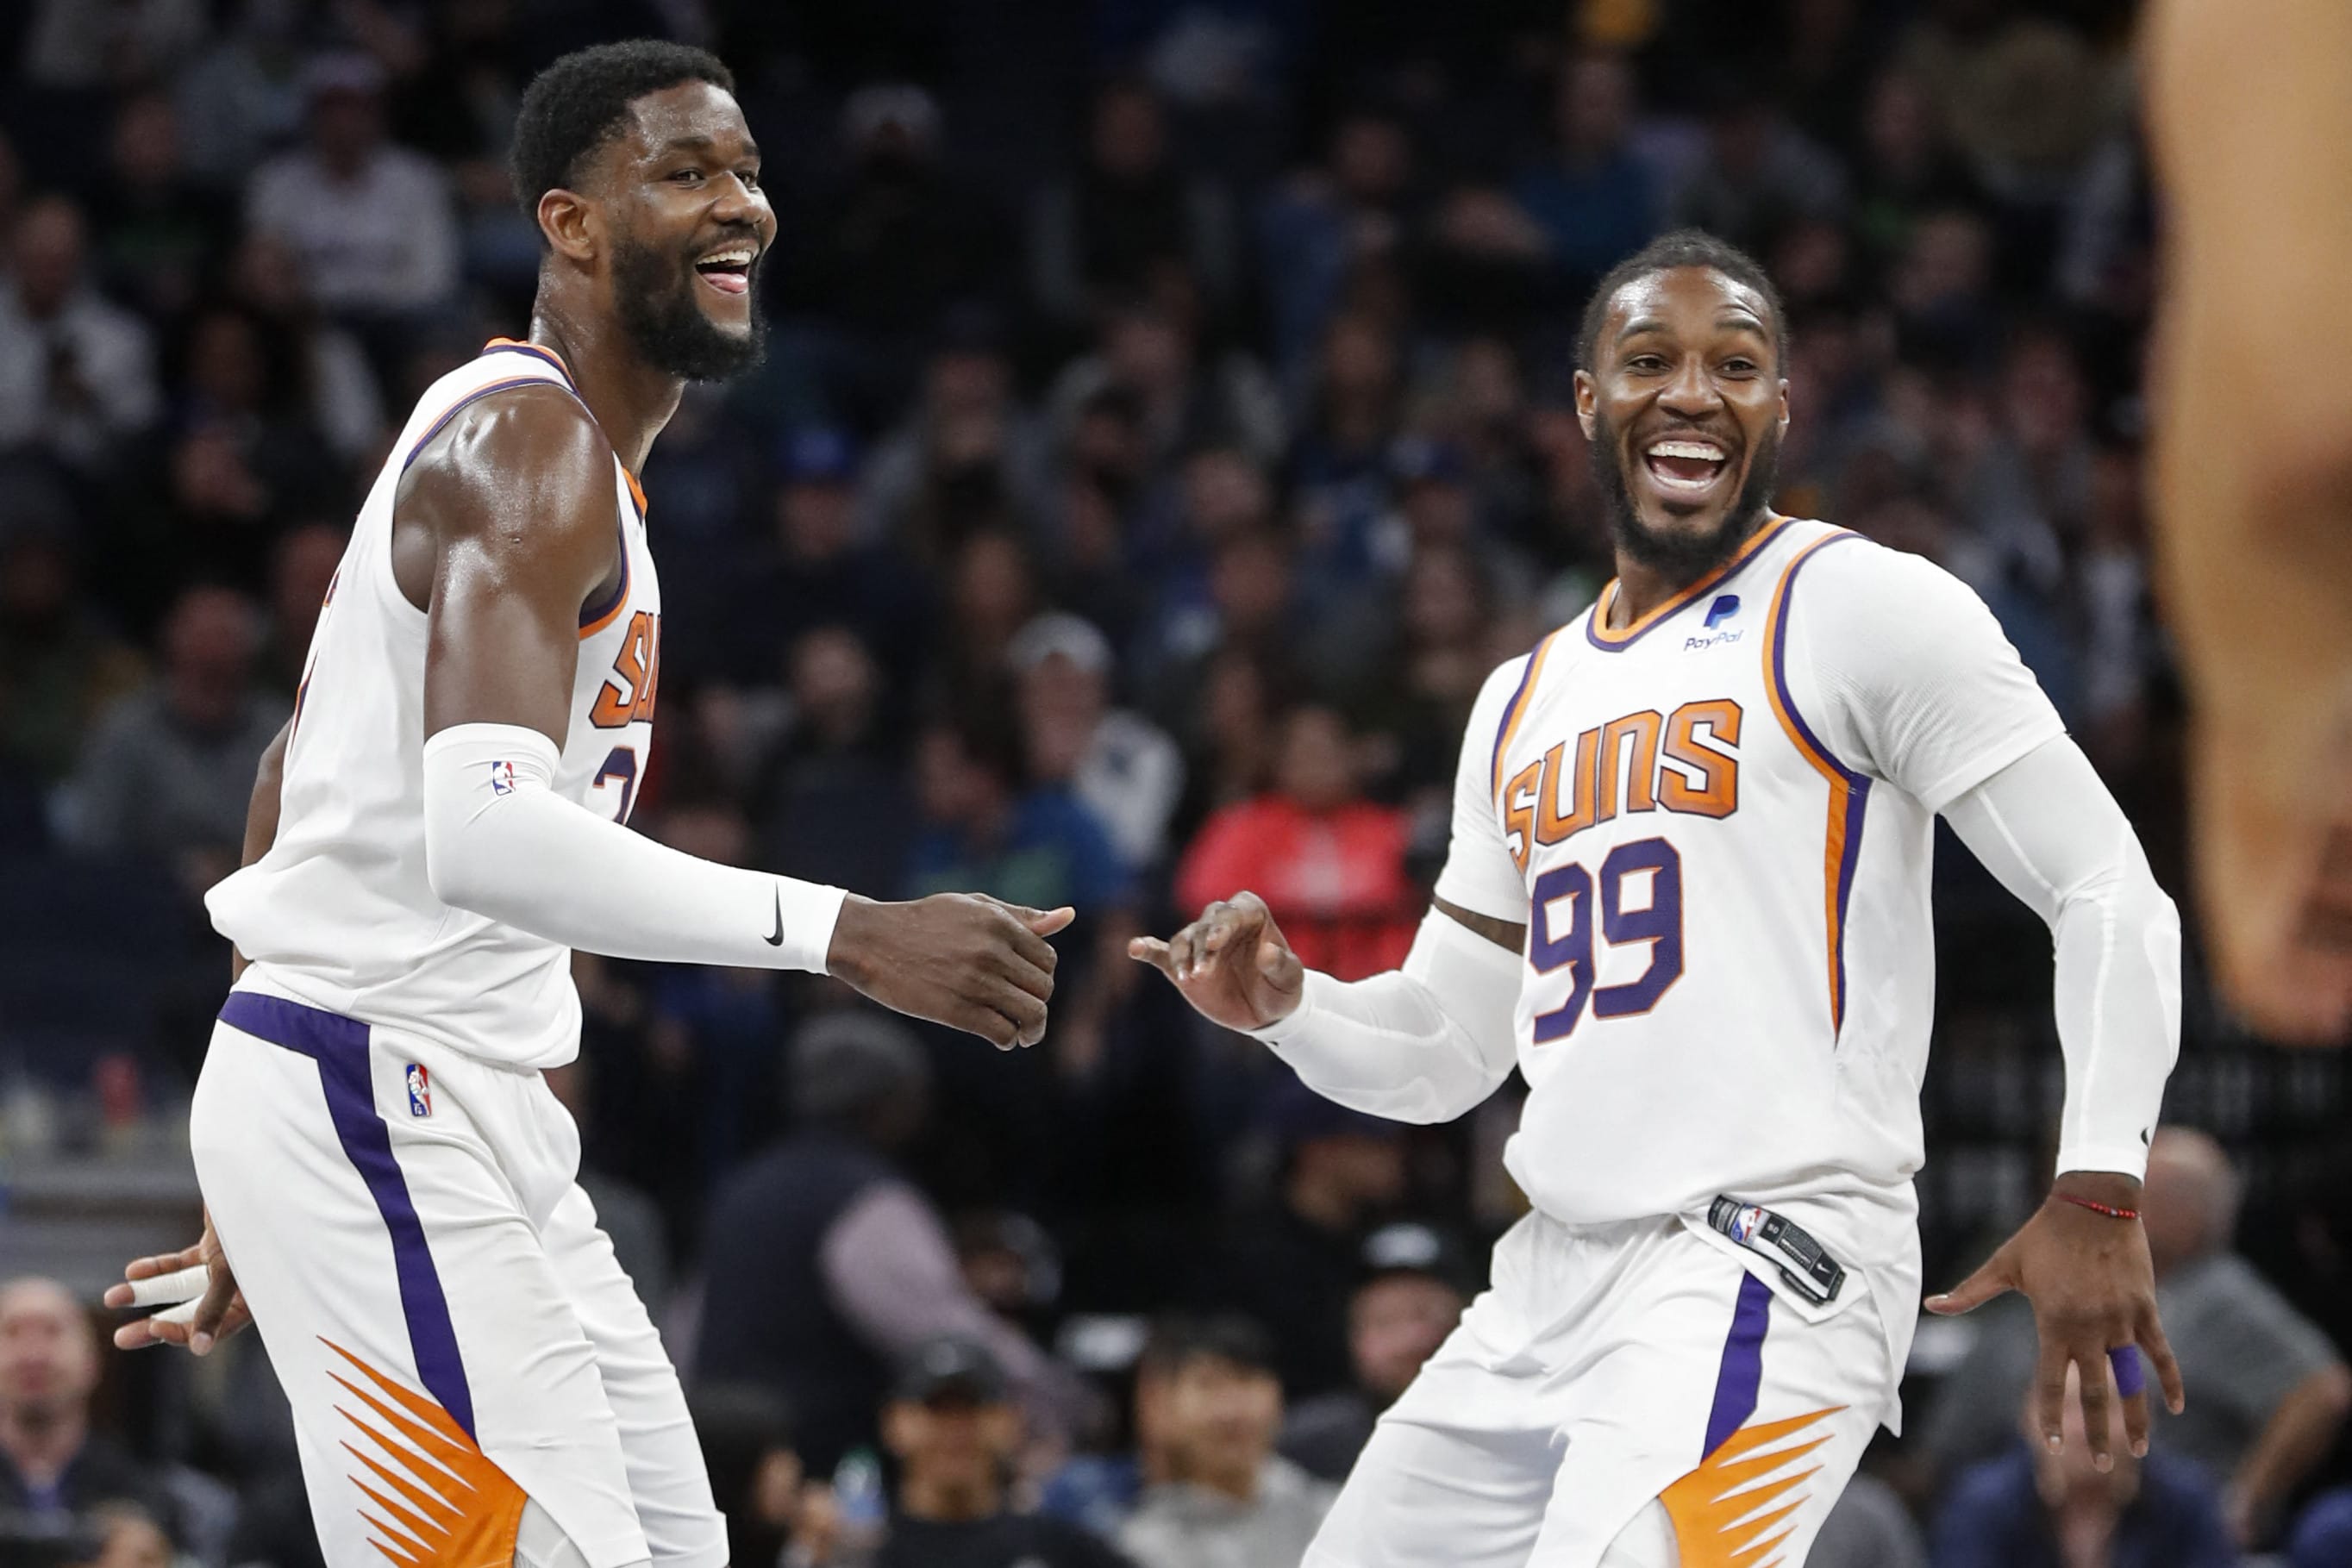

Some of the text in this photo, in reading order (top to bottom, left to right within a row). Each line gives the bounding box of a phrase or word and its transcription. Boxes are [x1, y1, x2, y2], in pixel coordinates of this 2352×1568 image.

[1684, 629, 1744, 652] PayPal
[1504, 698, 1742, 874] SUNS
[1529, 836, 1685, 1046] 99
